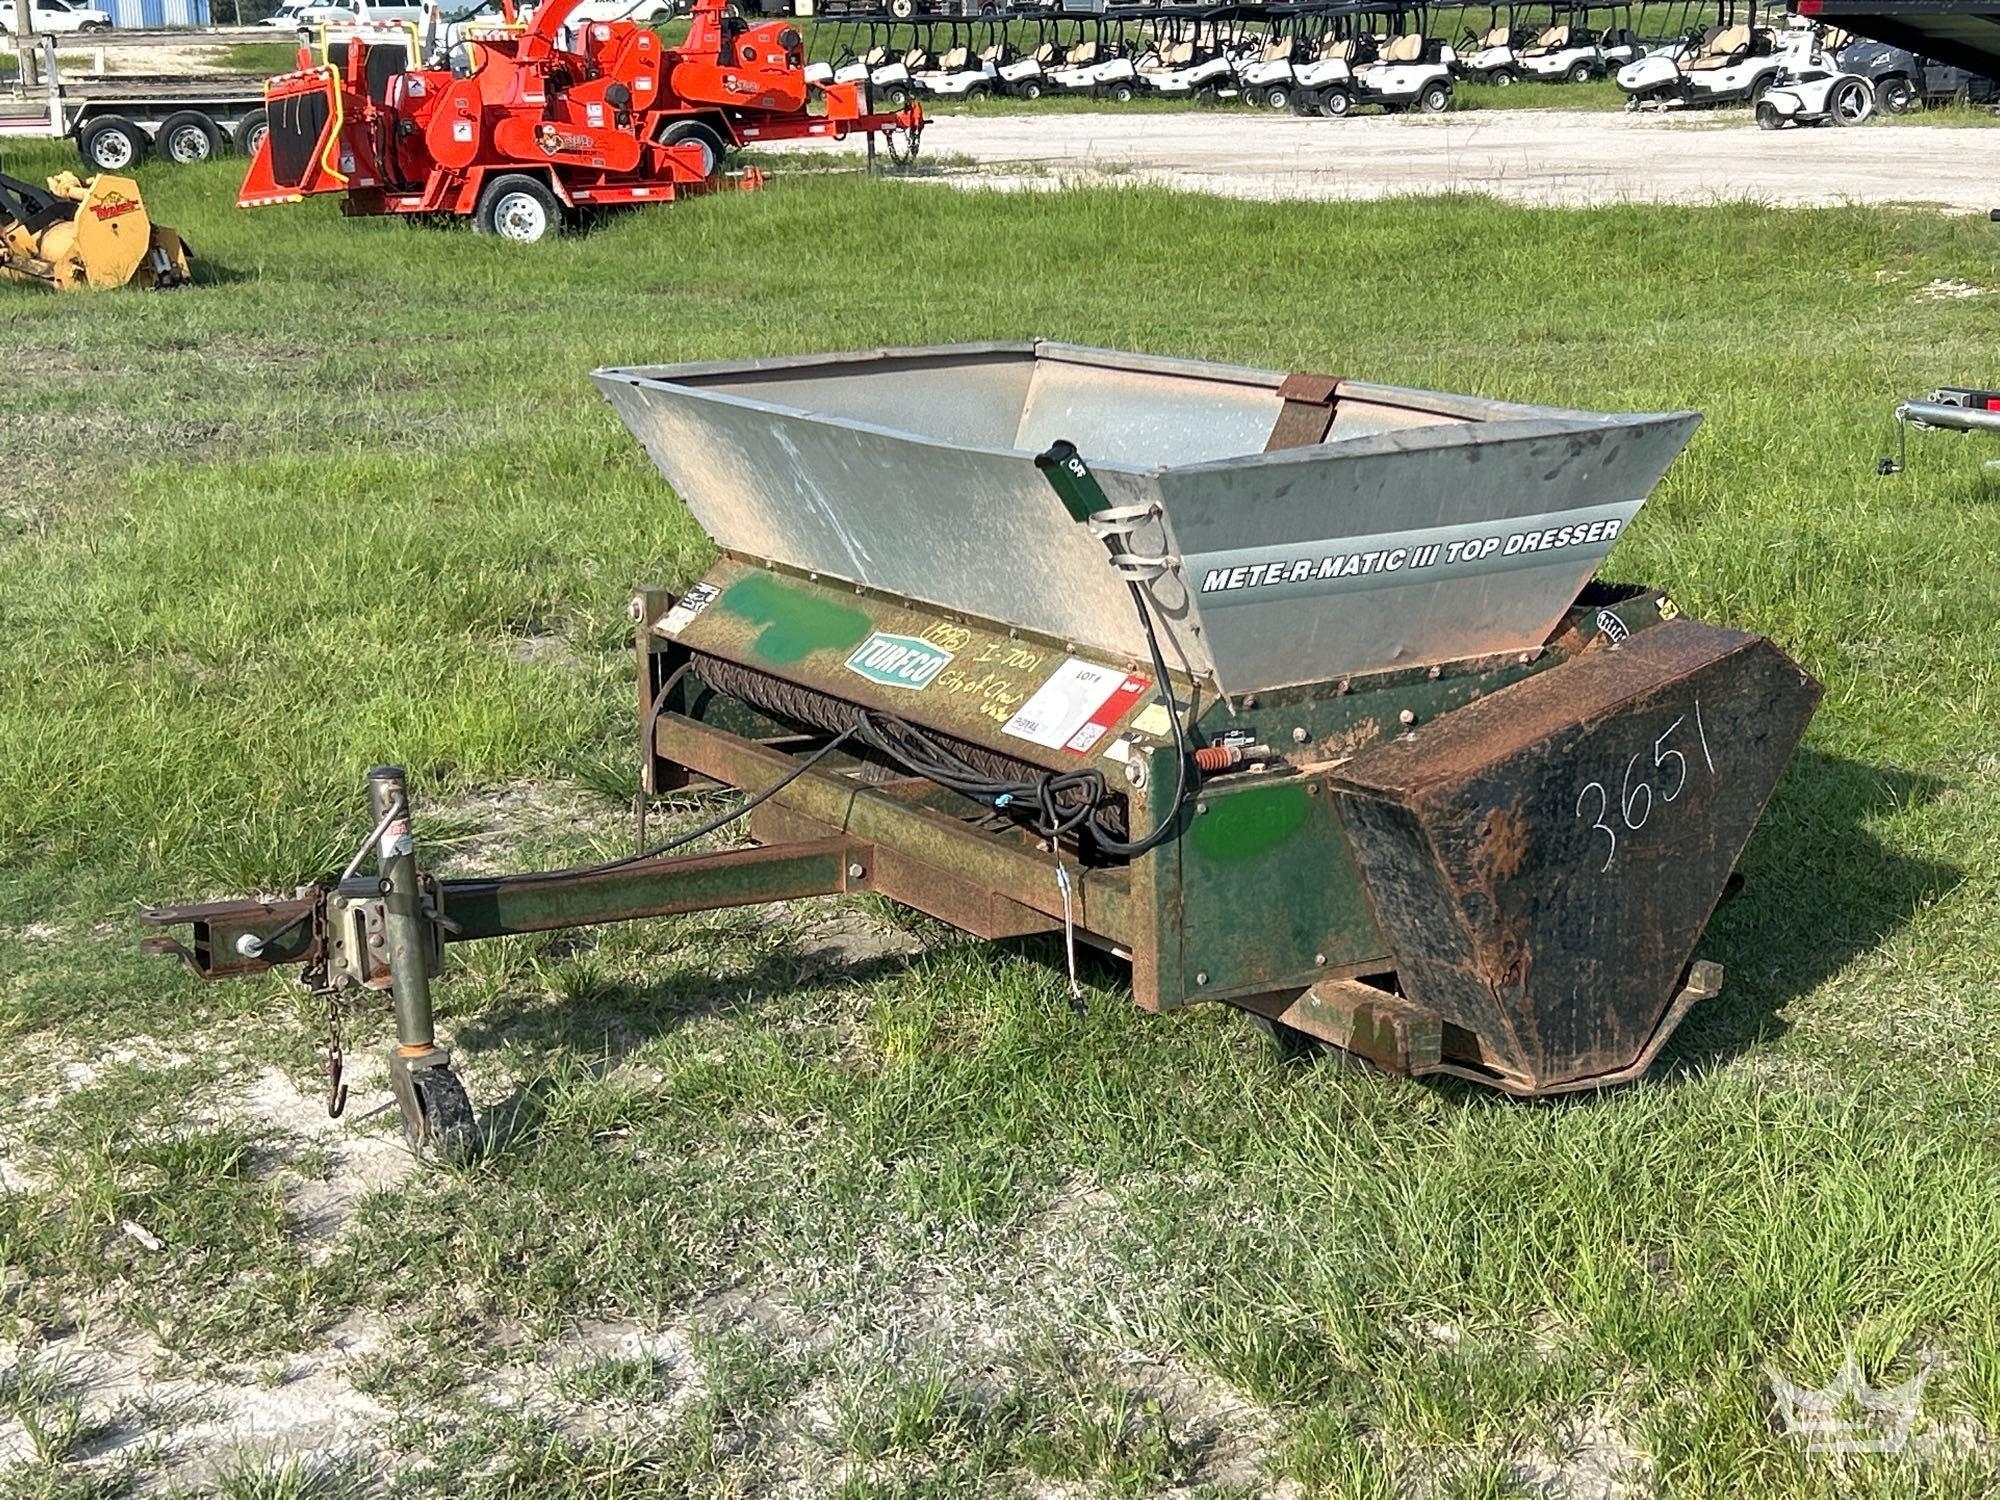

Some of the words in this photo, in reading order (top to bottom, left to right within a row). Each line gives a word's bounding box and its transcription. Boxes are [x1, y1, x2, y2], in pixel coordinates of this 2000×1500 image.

[1068, 458, 1086, 478] OFF
[1201, 548, 1407, 593] METE-R-MATIC
[1408, 543, 1442, 569] III
[1445, 536, 1500, 565] TOP
[1502, 518, 1622, 556] DRESSER
[853, 640, 945, 682] TURFCO
[1076, 669, 1096, 682] LOT
[938, 670, 965, 694] City
[964, 670, 995, 694] of
[1576, 699, 1715, 873] 3651
